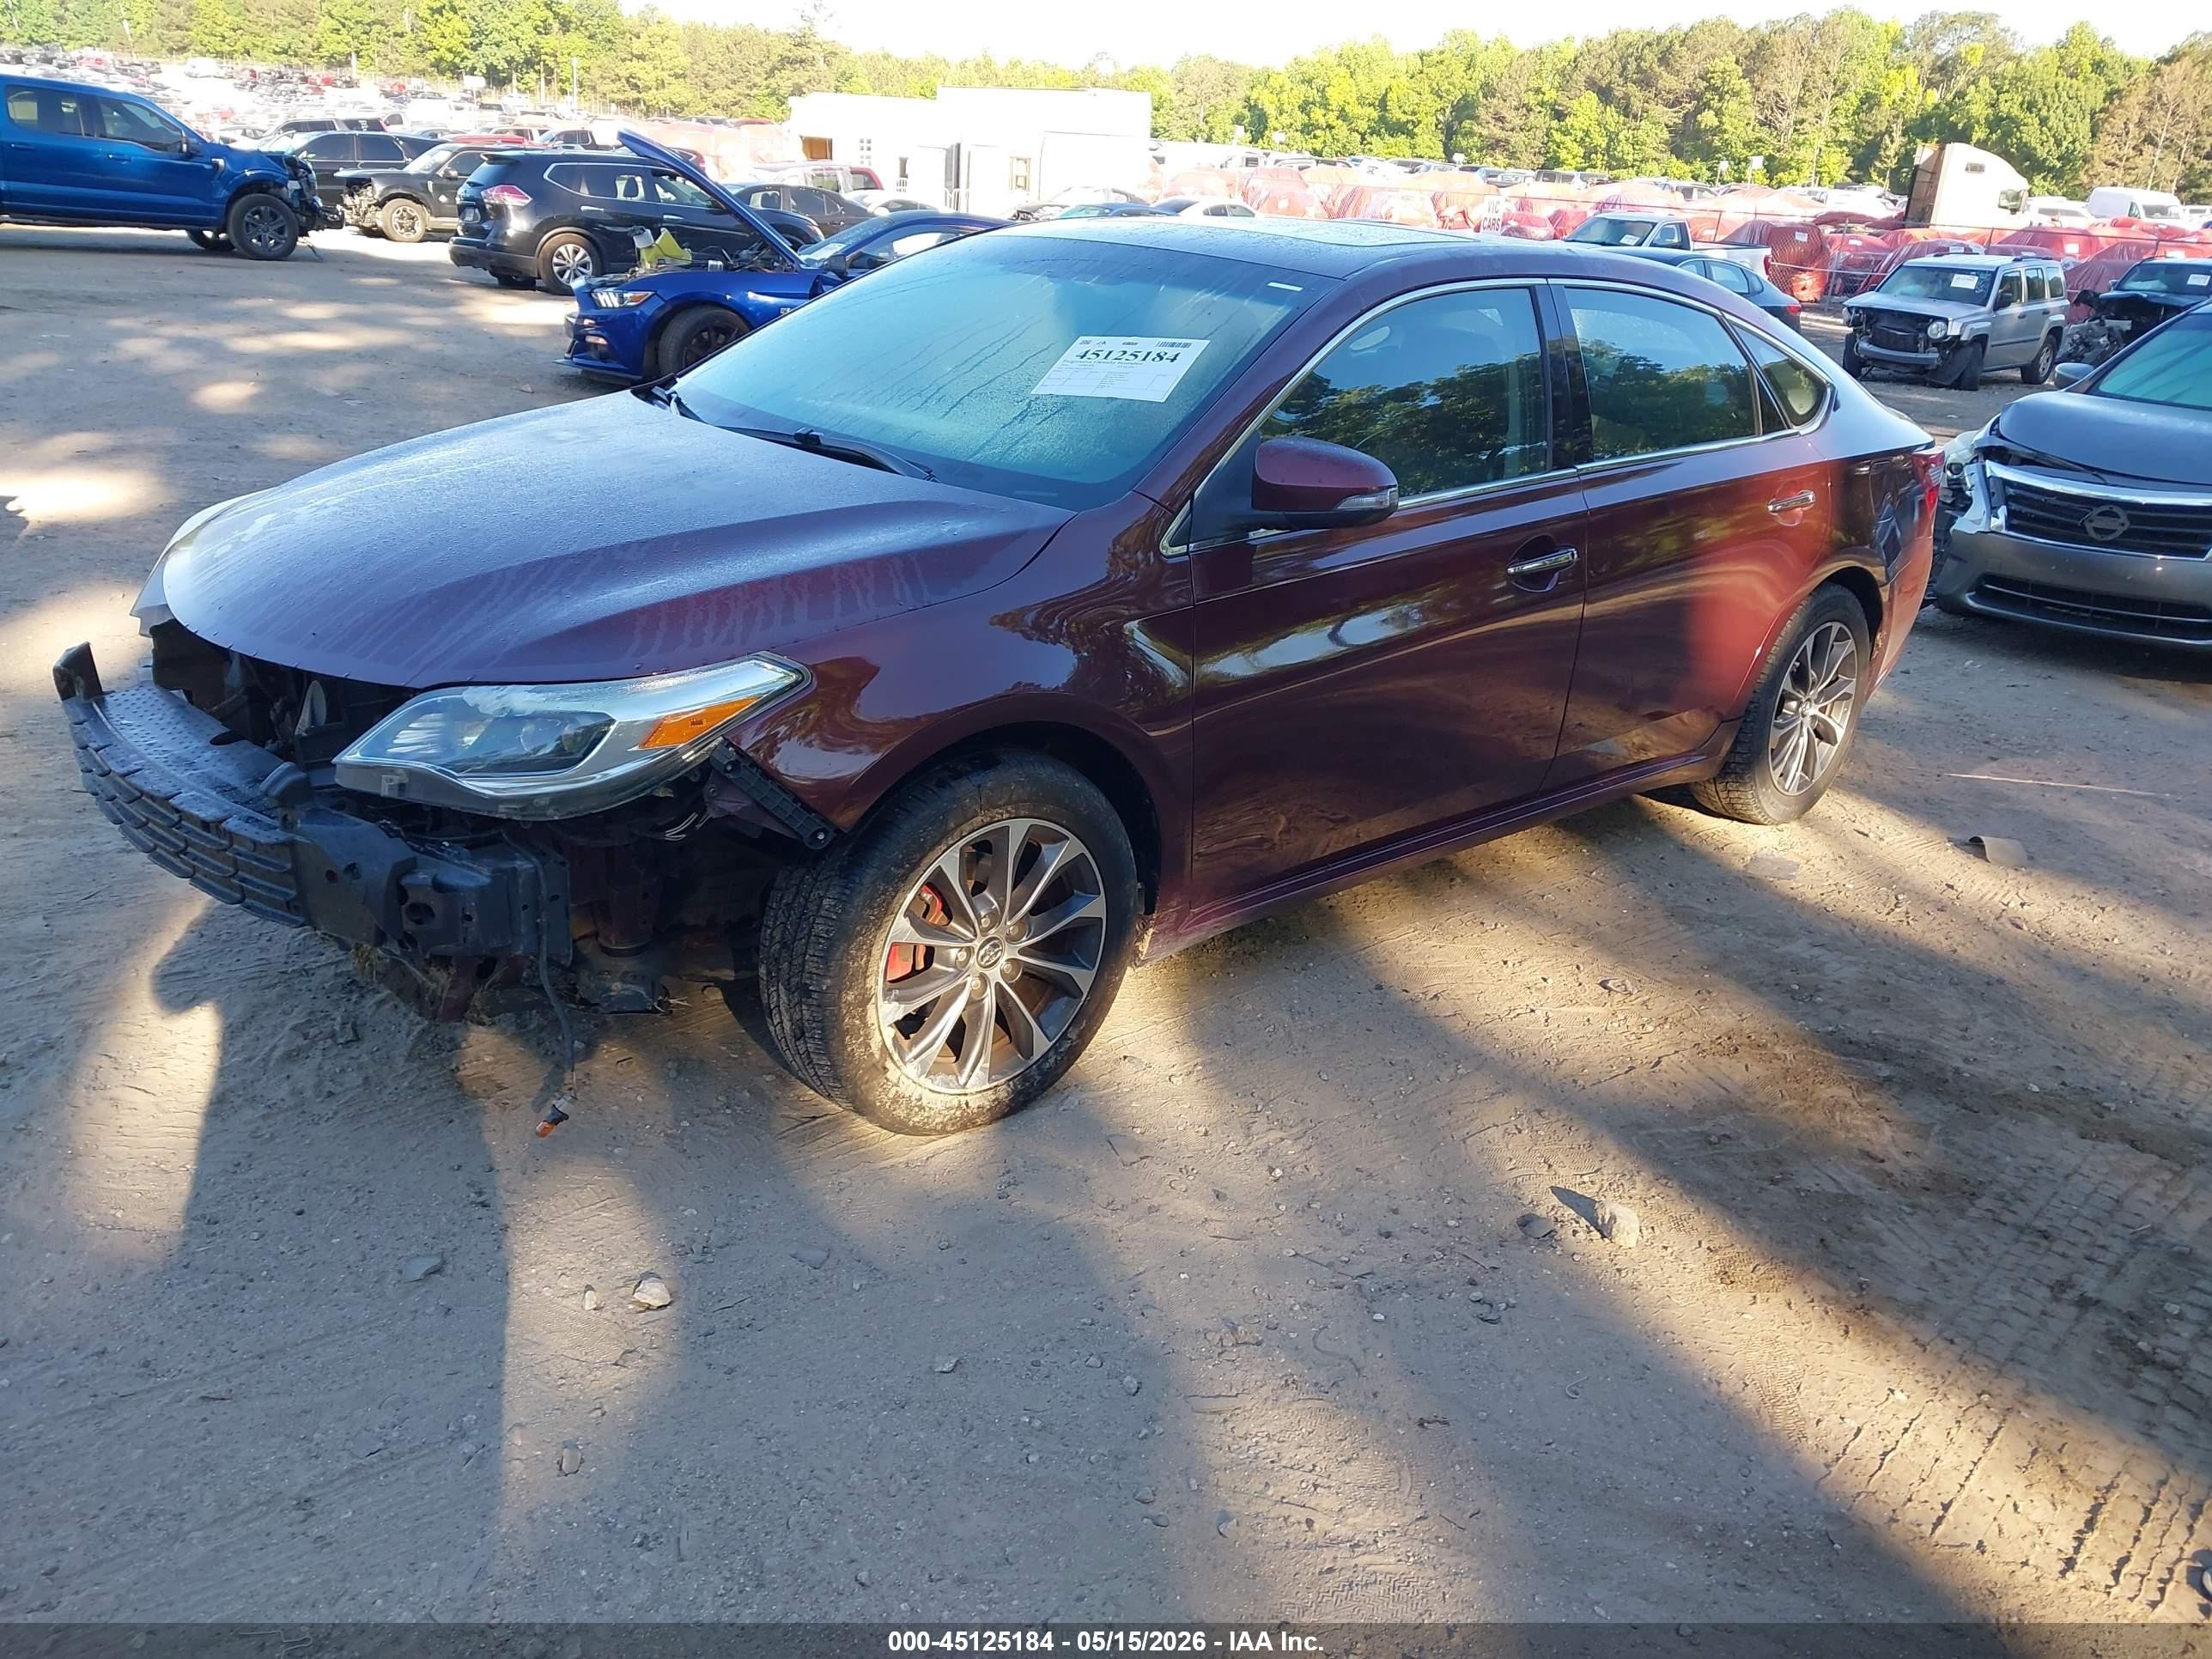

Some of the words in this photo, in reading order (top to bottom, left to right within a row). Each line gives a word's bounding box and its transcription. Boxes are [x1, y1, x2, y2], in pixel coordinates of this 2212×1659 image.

[1487, 200, 1500, 214] VIC
[1482, 217, 1501, 232] CARS
[1075, 349, 1182, 363] 45125184
